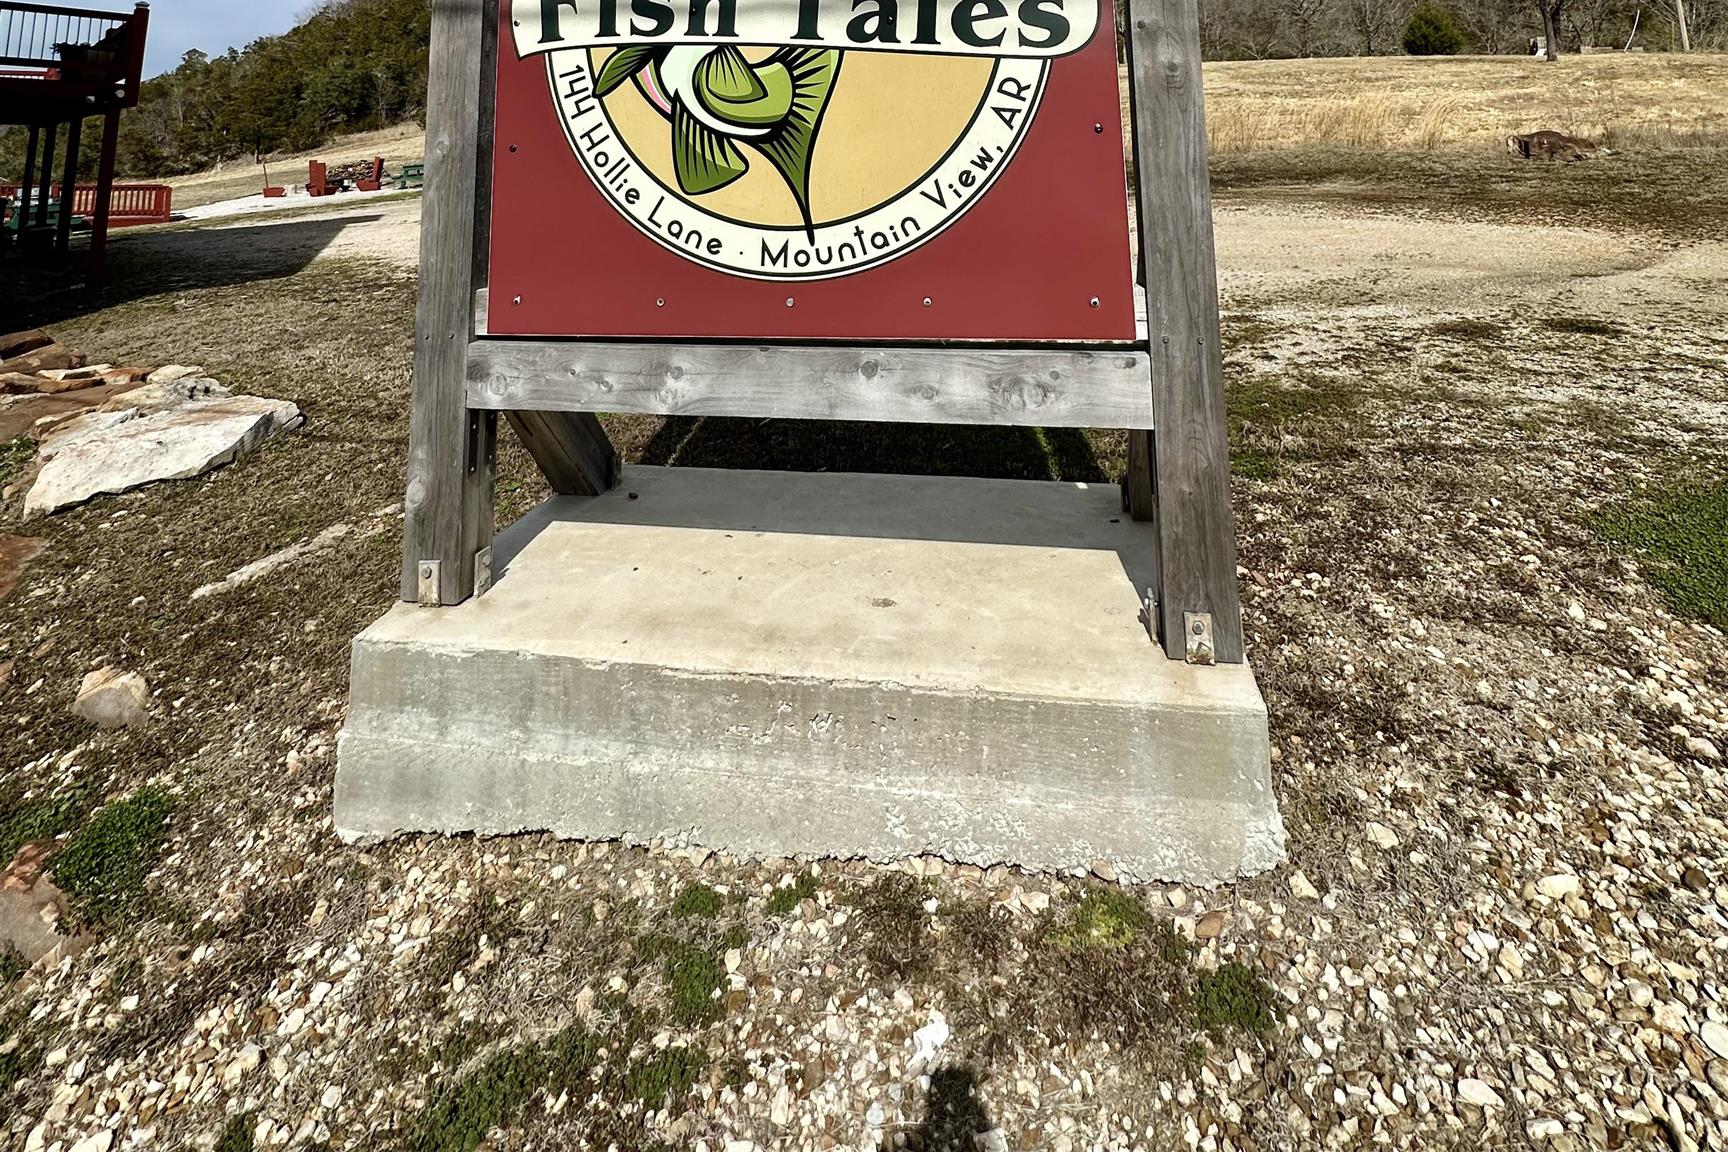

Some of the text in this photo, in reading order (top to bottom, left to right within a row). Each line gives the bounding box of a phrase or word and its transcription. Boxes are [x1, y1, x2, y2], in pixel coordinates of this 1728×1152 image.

[558, 64, 1032, 268] 144 Hollie Lane Mountain View, AR
